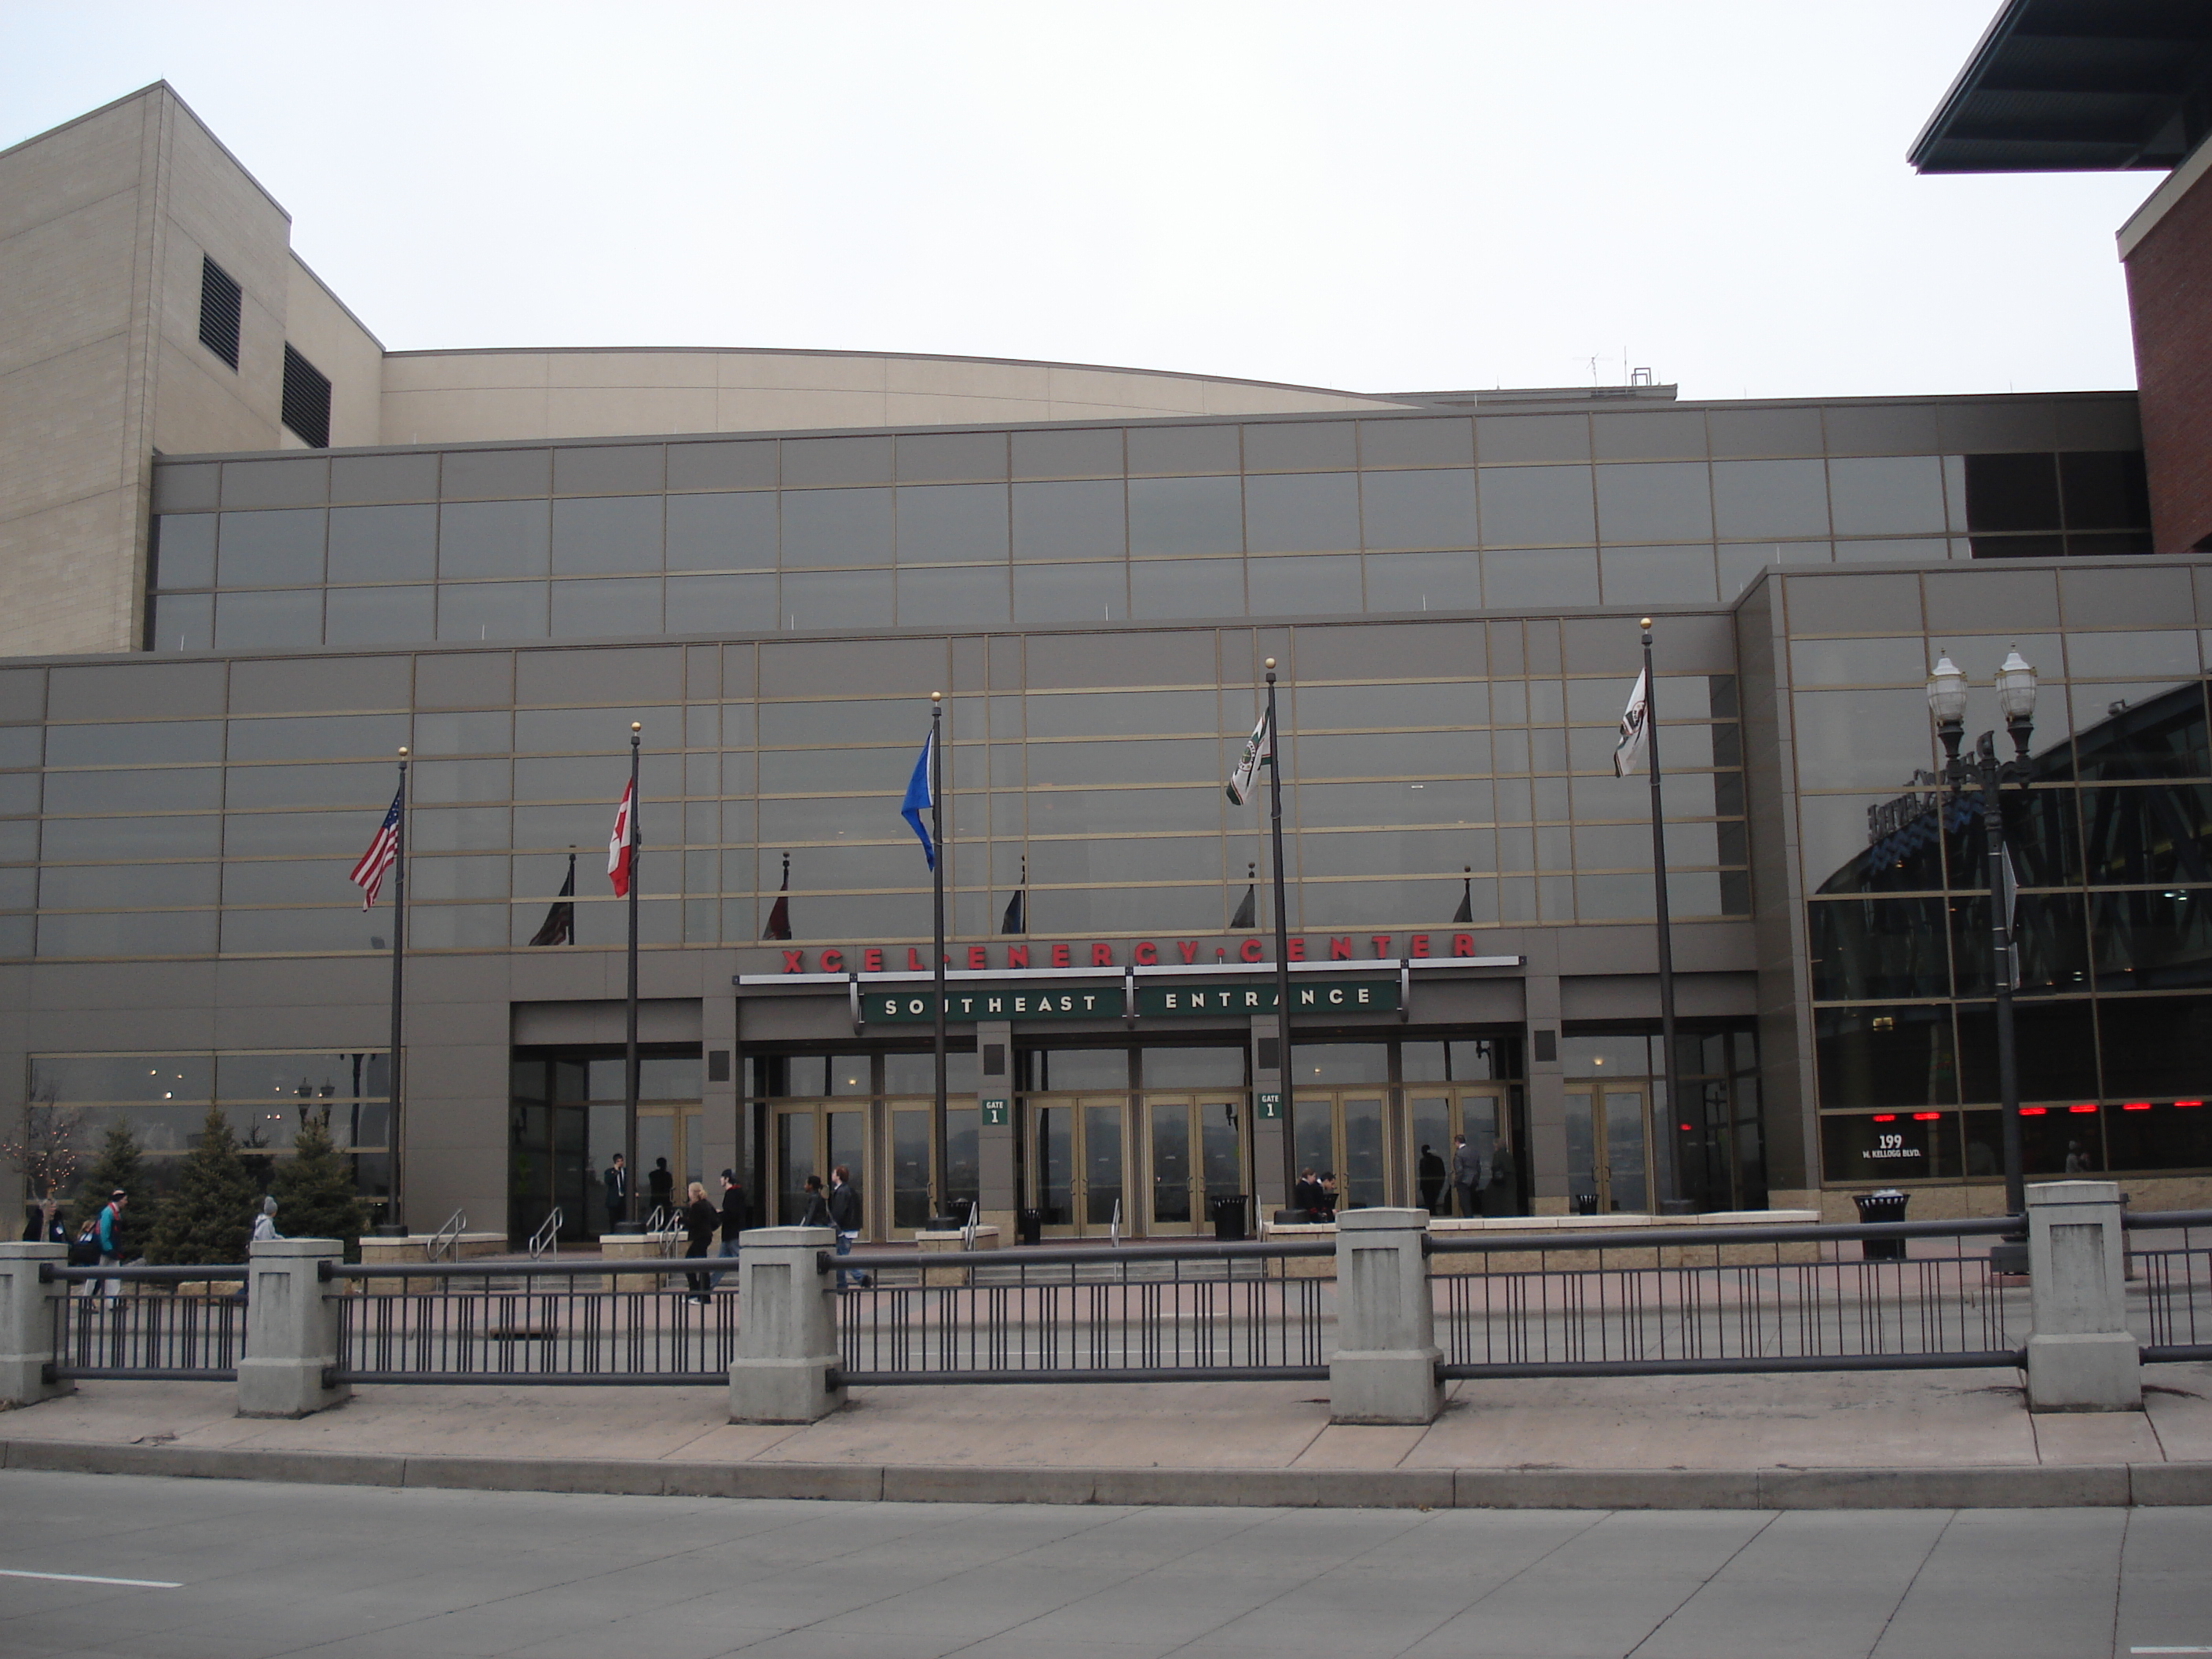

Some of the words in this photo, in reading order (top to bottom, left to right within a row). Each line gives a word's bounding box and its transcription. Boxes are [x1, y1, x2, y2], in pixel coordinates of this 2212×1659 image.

[782, 947, 924, 973] XCEL
[968, 941, 1198, 969] ENERGY
[1240, 933, 1475, 962] CENTER
[991, 1110, 998, 1123] 1
[1267, 1104, 1274, 1117] 1
[1879, 1134, 1903, 1149] 199
[1872, 1149, 1901, 1159] KELLOGG
[1902, 1148, 1921, 1158] BLVD.
